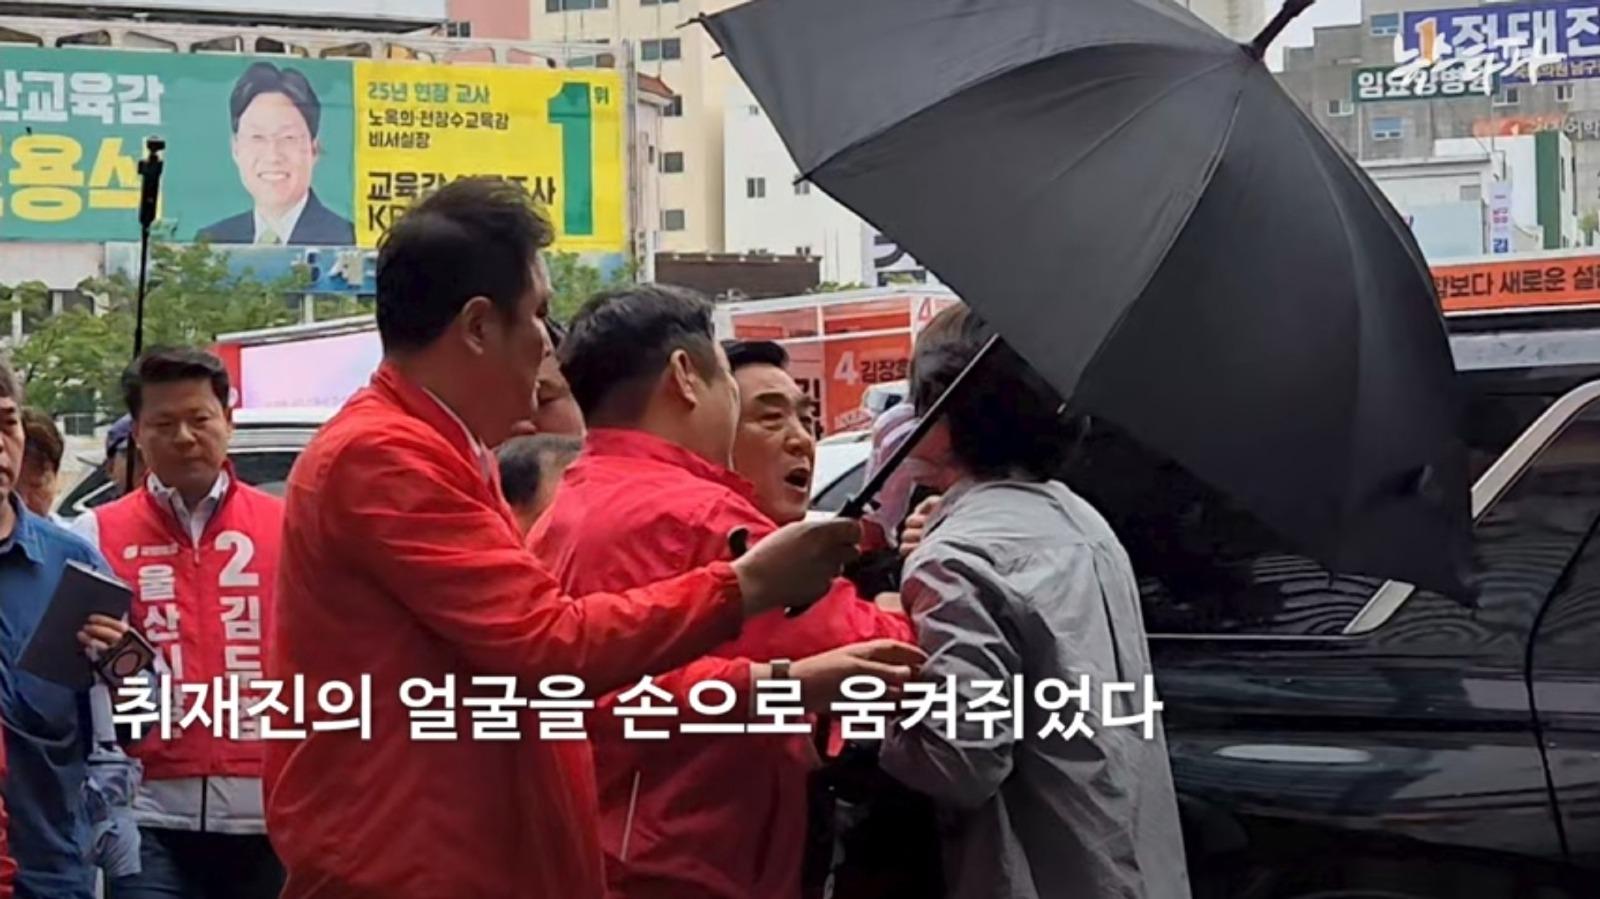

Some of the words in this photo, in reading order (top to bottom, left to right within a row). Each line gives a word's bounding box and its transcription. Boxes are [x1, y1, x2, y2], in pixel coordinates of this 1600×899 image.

[456, 84, 489, 106] 교사
[368, 131, 430, 149] 비서실장
[1500, 266, 1566, 294] 새로운
[1573, 264, 1600, 290] 설
[833, 350, 859, 385] 4
[214, 530, 260, 587] 2
